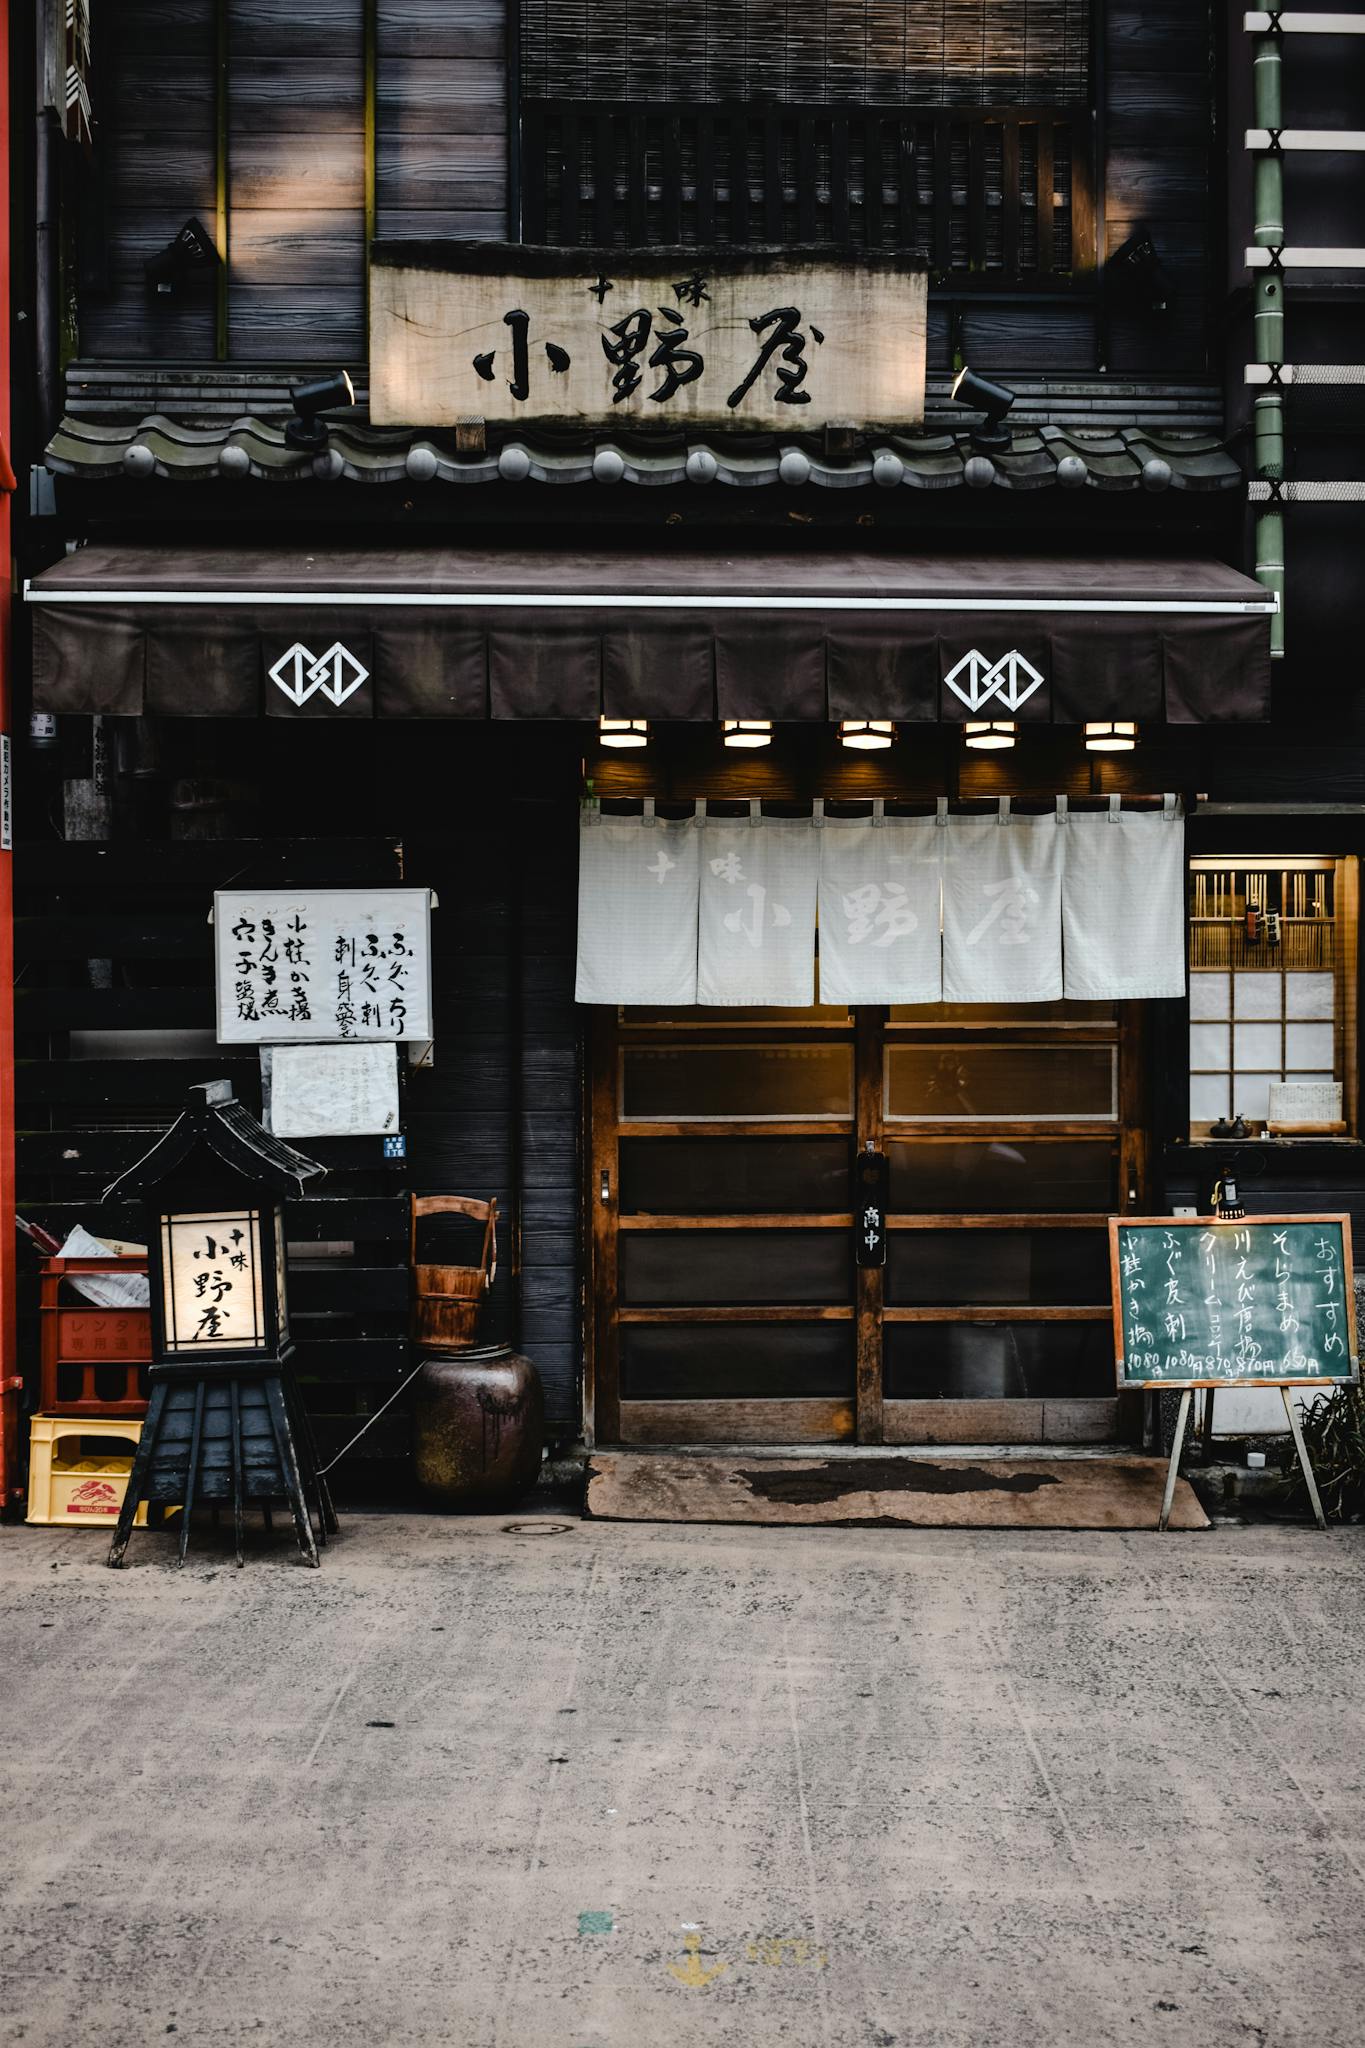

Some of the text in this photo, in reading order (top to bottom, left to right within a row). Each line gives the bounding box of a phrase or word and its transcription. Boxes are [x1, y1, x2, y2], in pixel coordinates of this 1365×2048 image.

[472, 306, 825, 408] 小野屋
[724, 881, 1038, 946] 小野屋
[360, 933, 387, 1028] ふぐ刺
[387, 932, 414, 1036] ふぐちり
[230, 1229, 249, 1272] 十味
[863, 1206, 880, 1251] 商中
[193, 1236, 233, 1341] 小野屋
[1162, 1231, 1186, 1343] ふぐ皮刺
[1200, 1231, 1222, 1357] クリームコロッケ
[1233, 1230, 1262, 1358] 川えび唐揚
[1272, 1230, 1300, 1333] そらまめ
[1313, 1237, 1345, 1356] おすすめ
